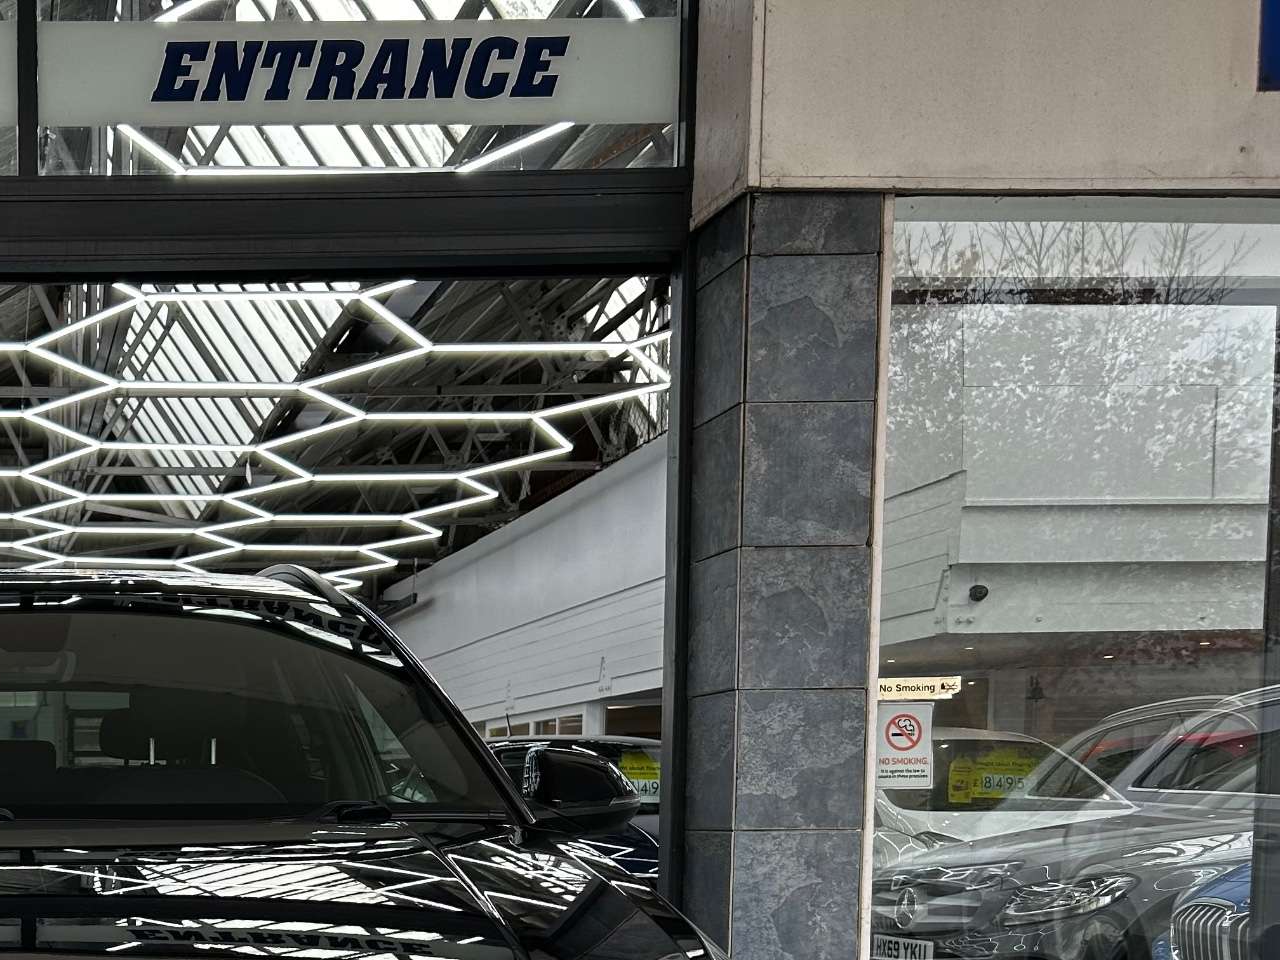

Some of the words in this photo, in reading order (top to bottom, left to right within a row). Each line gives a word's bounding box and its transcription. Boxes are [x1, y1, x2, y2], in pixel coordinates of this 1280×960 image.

[151, 35, 570, 102] ENTRANCE
[896, 684, 935, 693] Smoking
[879, 757, 890, 765] NO
